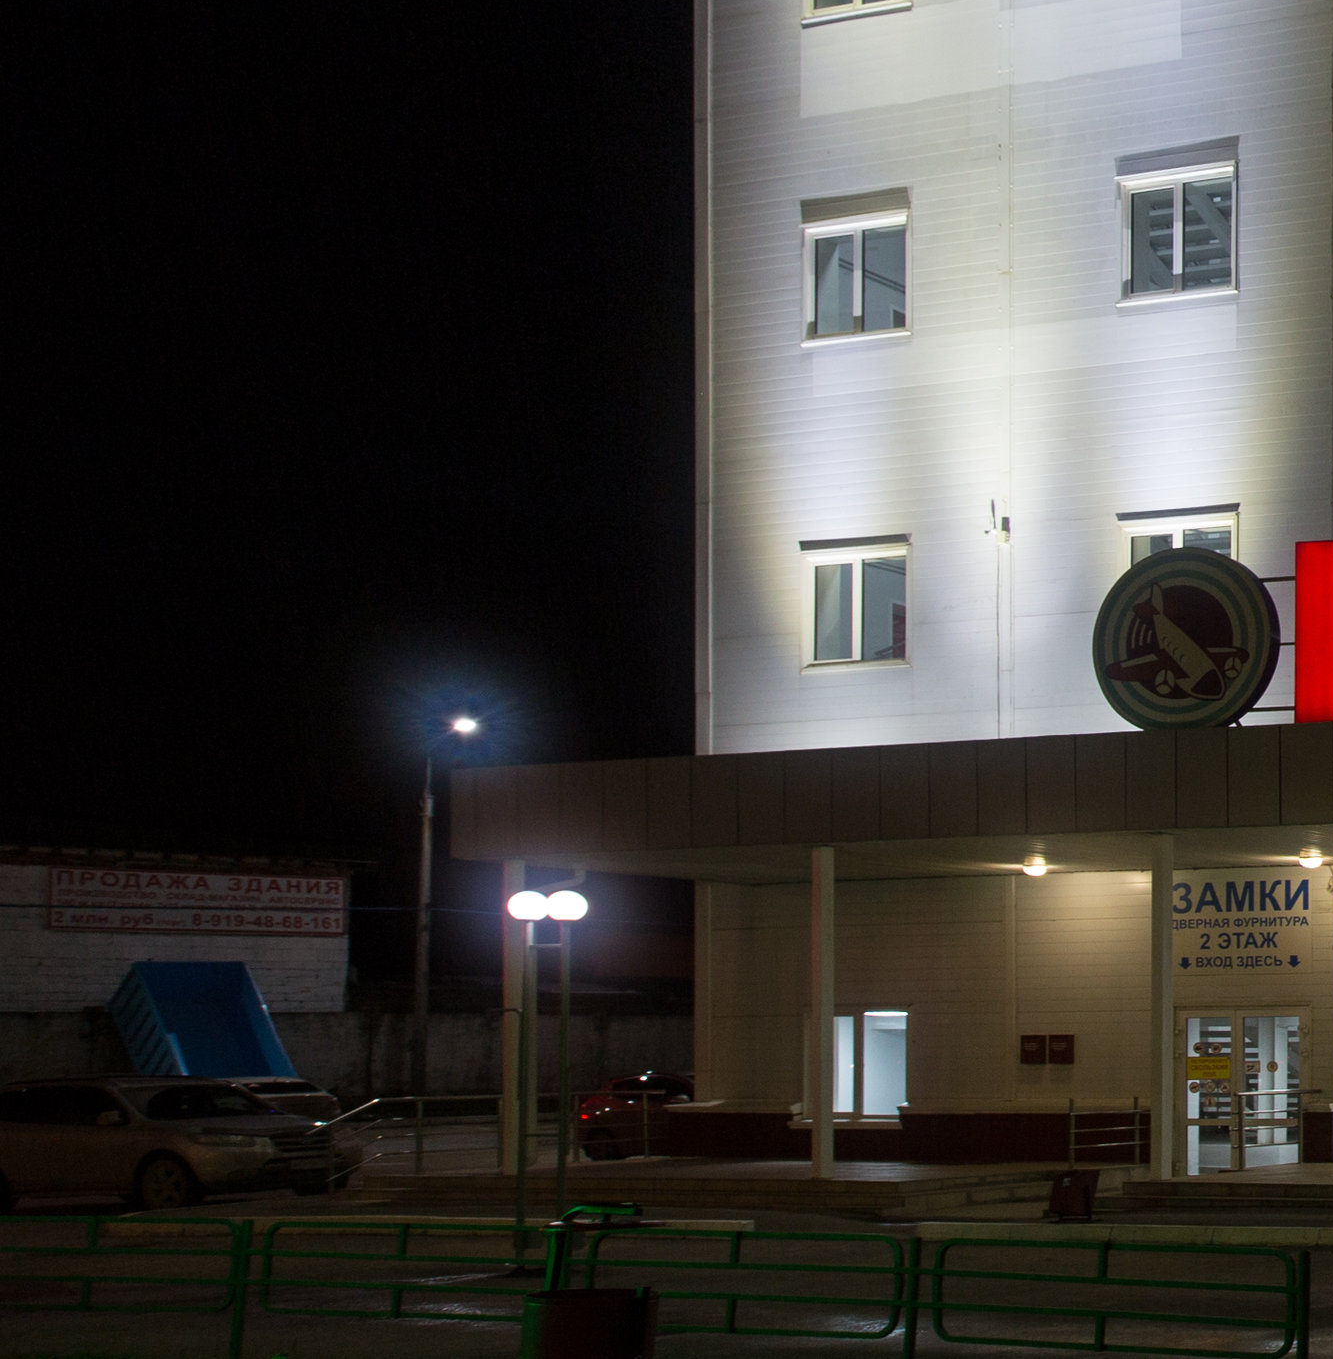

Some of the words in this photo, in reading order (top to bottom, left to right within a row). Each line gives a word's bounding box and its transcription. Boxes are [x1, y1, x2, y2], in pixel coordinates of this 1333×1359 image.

[57, 871, 209, 890] ПРОДАЖА
[228, 878, 340, 894] ЗДАНИЯ
[1172, 880, 1309, 914] ЗАМКИ
[55, 911, 64, 923] 2
[1172, 918, 1230, 929] ДВЕРНАЯ
[1233, 916, 1309, 929] ФУРНИТУРА
[1200, 933, 1210, 950] 2
[1217, 932, 1278, 950] ЭТАЖ
[1195, 956, 1233, 969] ВХОД
[1236, 955, 1283, 968] ЗДЕСЬ
